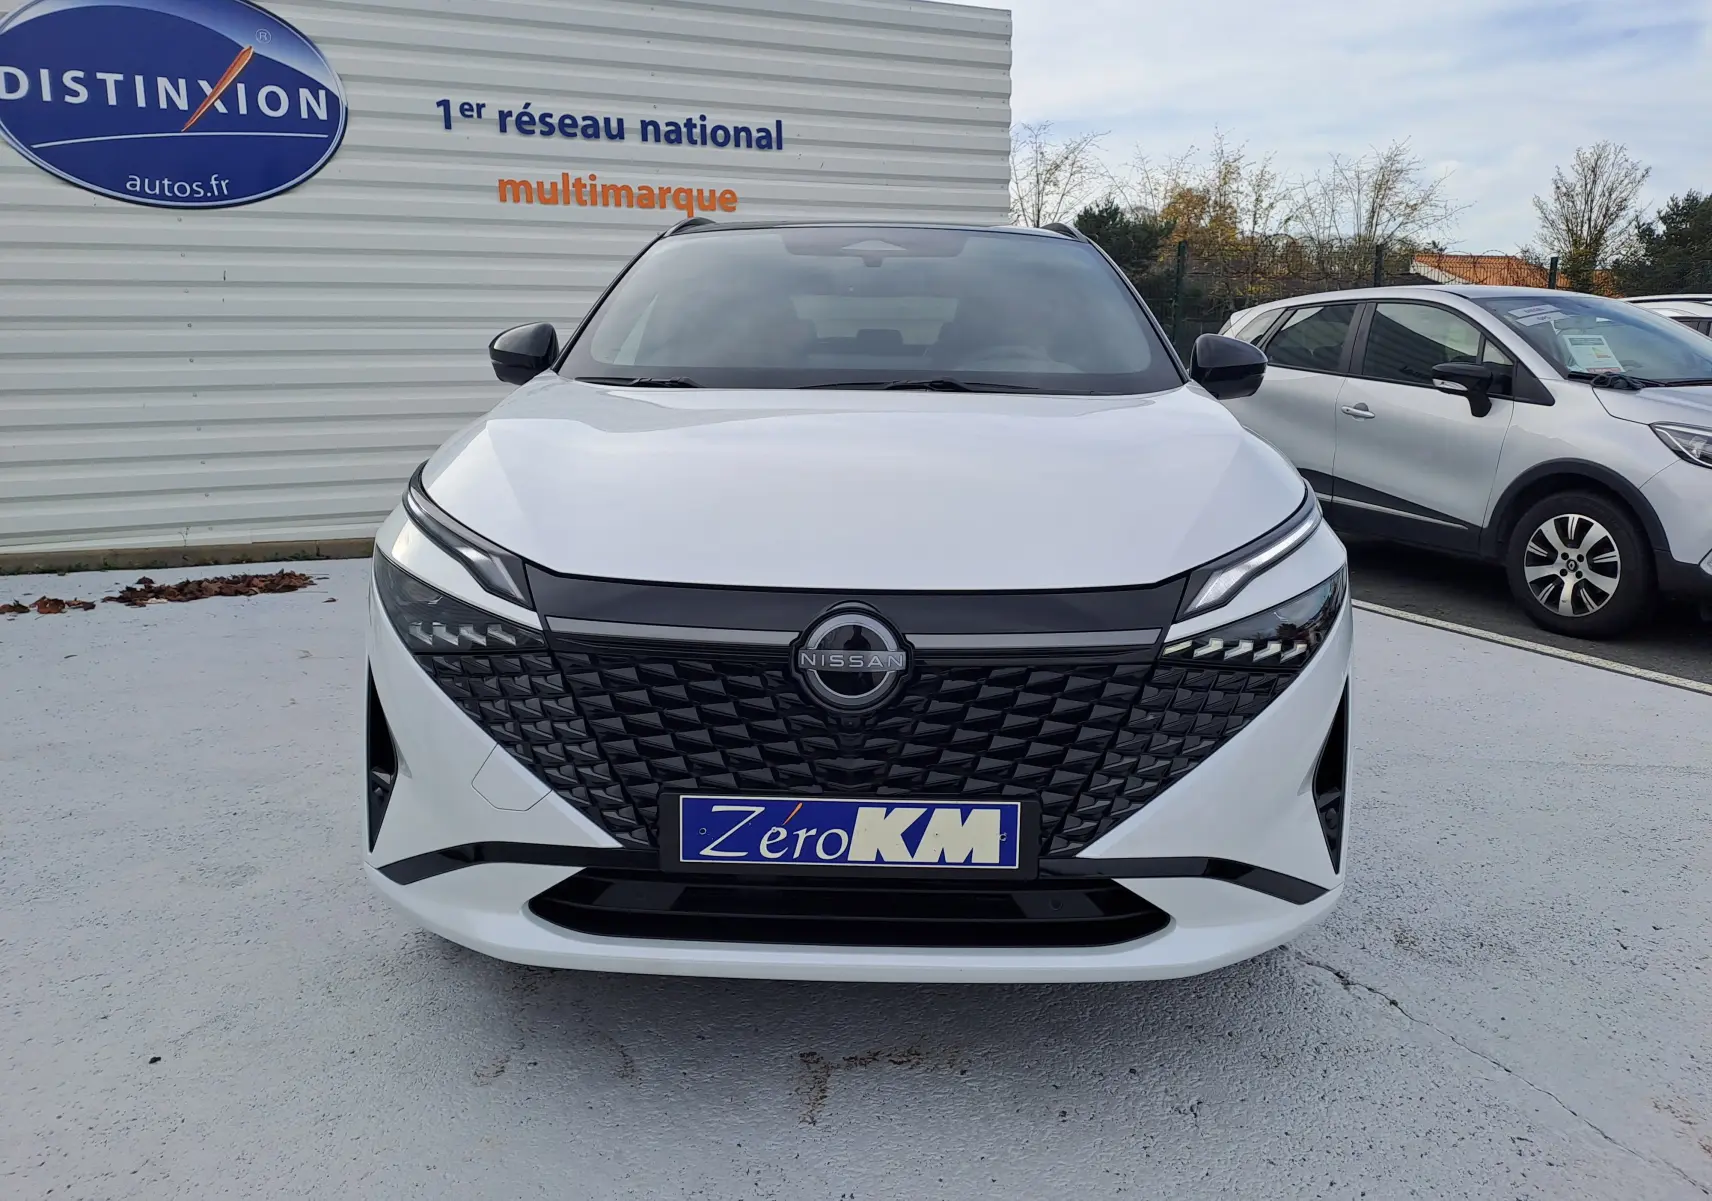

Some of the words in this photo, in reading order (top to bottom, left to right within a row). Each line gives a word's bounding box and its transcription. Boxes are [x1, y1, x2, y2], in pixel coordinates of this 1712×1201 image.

[0, 60, 329, 123] DISTINXION
[498, 102, 625, 140] réseau
[639, 114, 784, 150] national
[126, 173, 230, 198] autos.fr
[498, 172, 738, 217] multimarque
[800, 652, 904, 668] NISSAN
